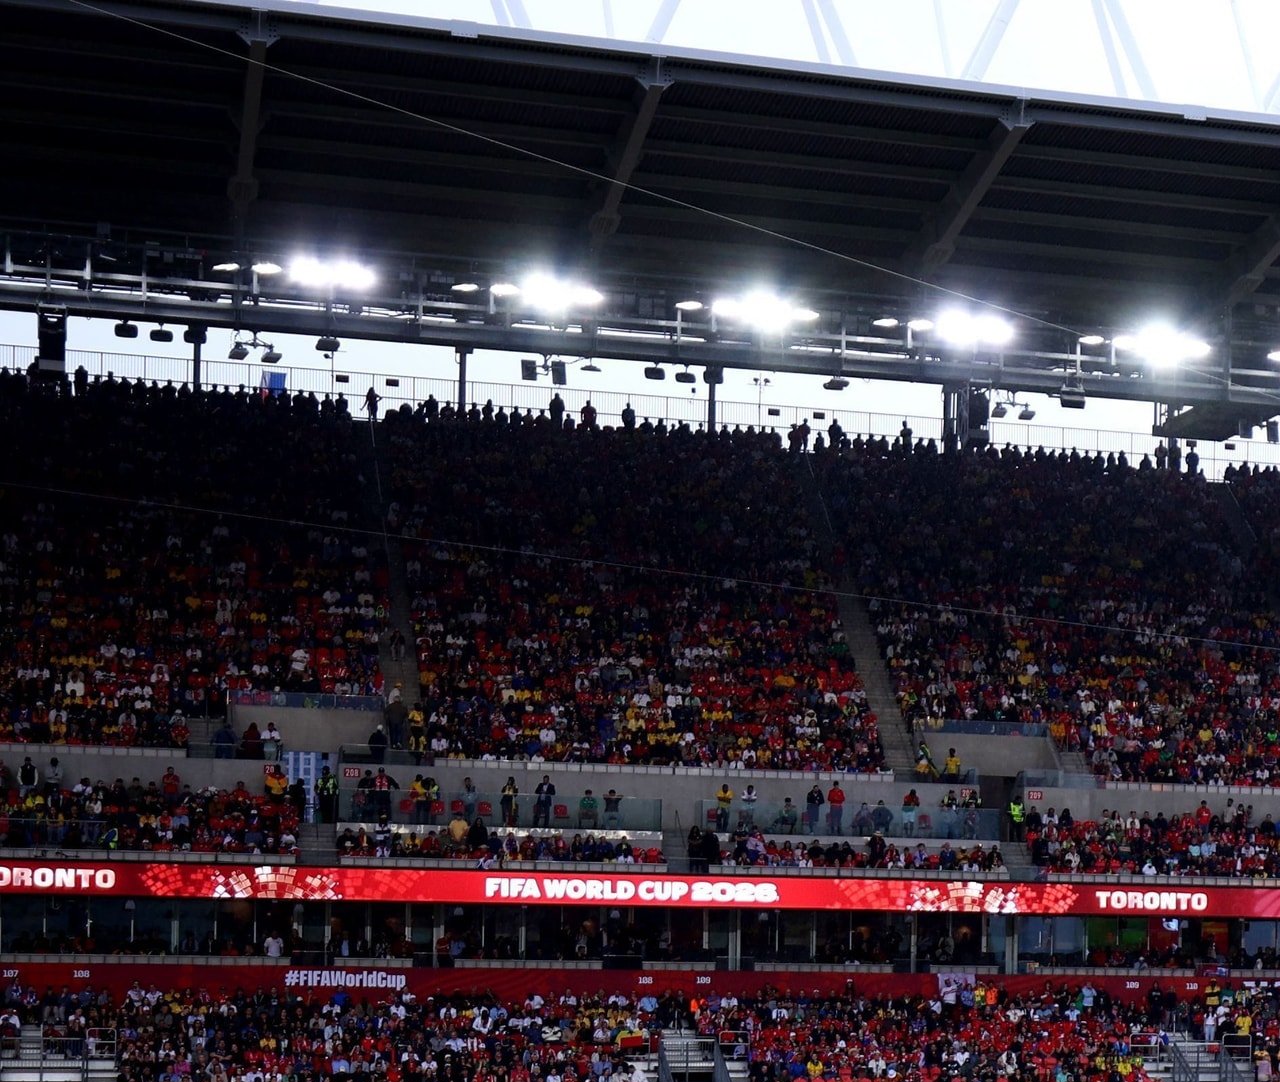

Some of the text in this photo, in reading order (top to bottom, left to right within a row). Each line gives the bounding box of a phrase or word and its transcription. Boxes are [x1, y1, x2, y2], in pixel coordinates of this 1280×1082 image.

[485, 877, 779, 903] FIFA WORLD CUP 2026
[1095, 890, 1208, 911] TORONTO
[3, 970, 19, 978] 107
[74, 970, 90, 978] 108
[284, 969, 406, 990] #FIFAWorldCup
[638, 976, 653, 985] 108
[696, 976, 711, 985] 109
[1126, 981, 1139, 989] 109
